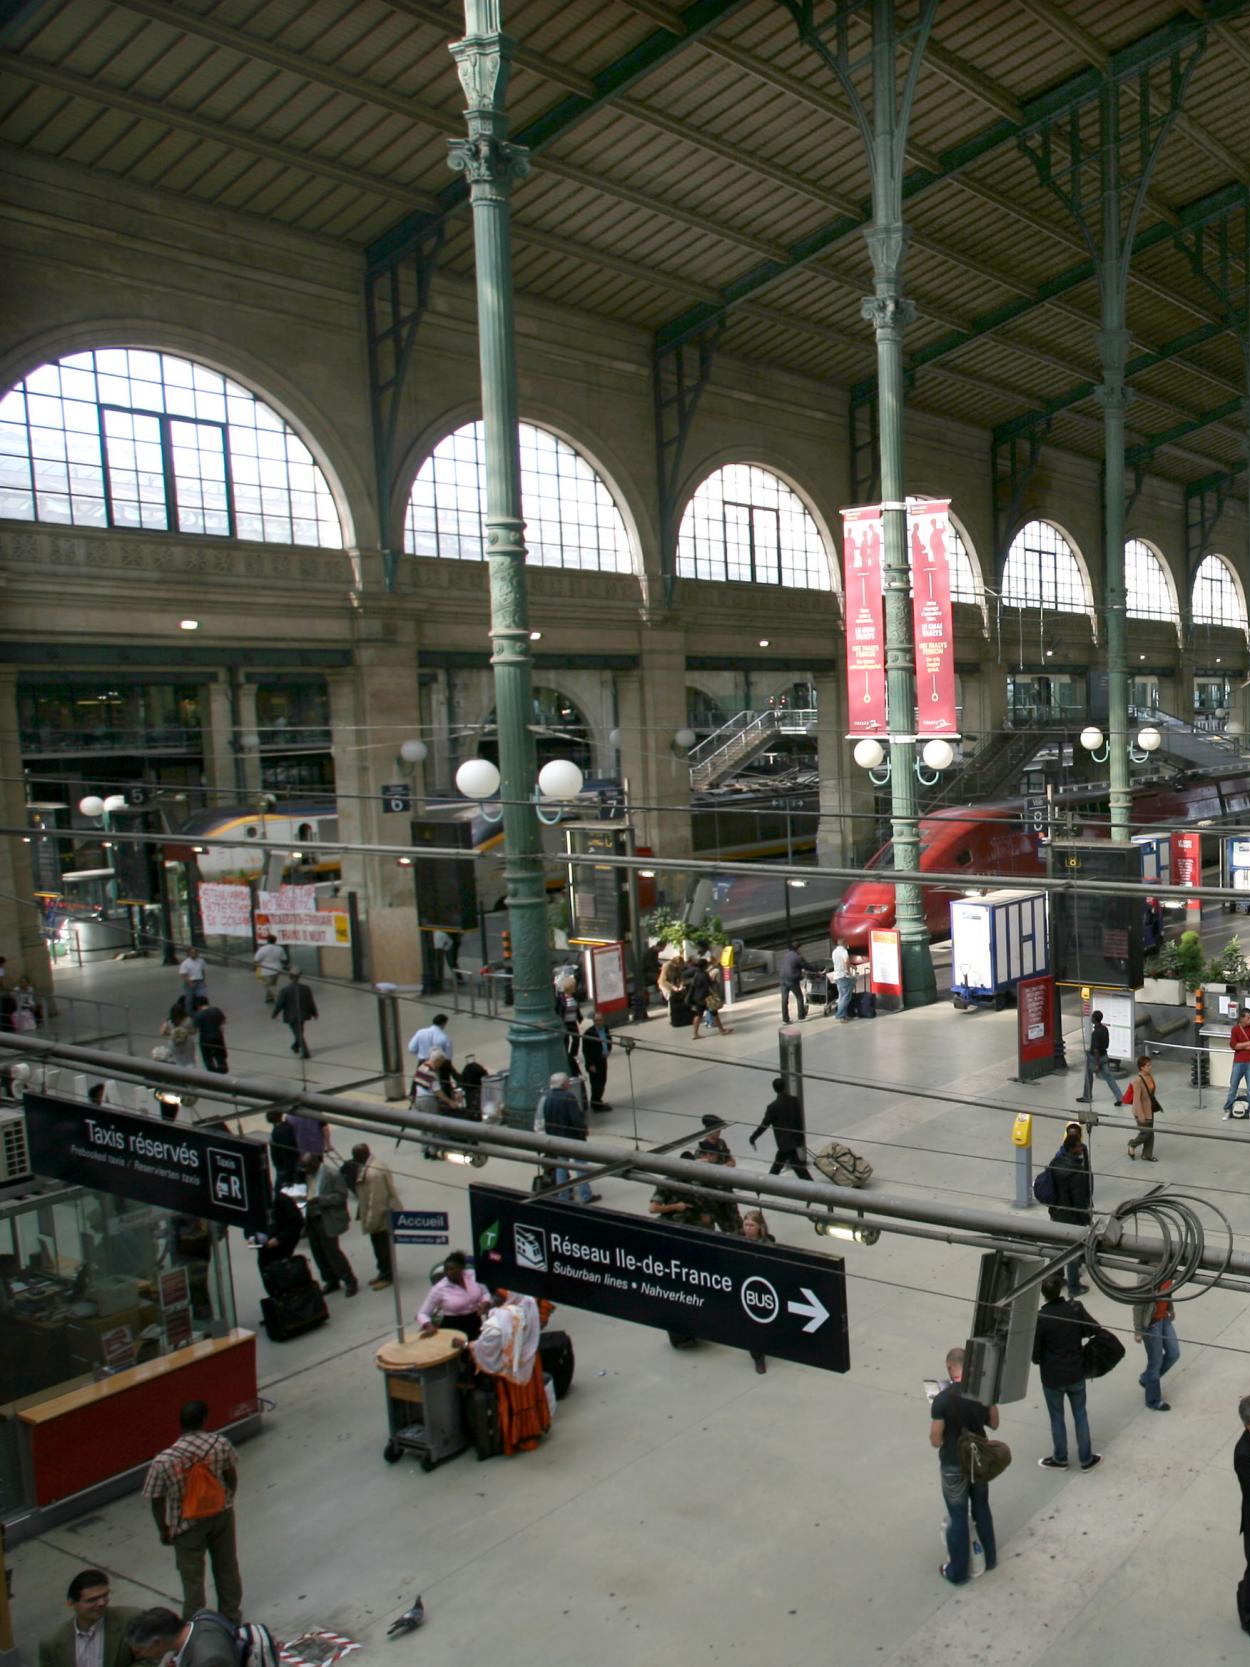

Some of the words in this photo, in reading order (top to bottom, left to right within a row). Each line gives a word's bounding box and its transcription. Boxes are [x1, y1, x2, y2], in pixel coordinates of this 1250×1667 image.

[391, 795, 404, 811] 6
[607, 800, 617, 818] 7
[84, 1118, 125, 1150] Taxis
[129, 1134, 200, 1168] réservés
[70, 1144, 106, 1163] Prebooked
[108, 1151, 125, 1166] taxis
[182, 1171, 200, 1186] taxis
[214, 1155, 236, 1170] Taxis
[230, 1176, 242, 1200] R
[397, 1214, 444, 1227] Accueil
[487, 1231, 496, 1247] T
[550, 1233, 610, 1265] Réseau
[615, 1246, 733, 1292] Ile-de-France
[552, 1260, 601, 1285] Suburban
[604, 1272, 628, 1290] lines
[640, 1282, 705, 1308] Nahverkehr
[746, 1290, 775, 1310] BUS
